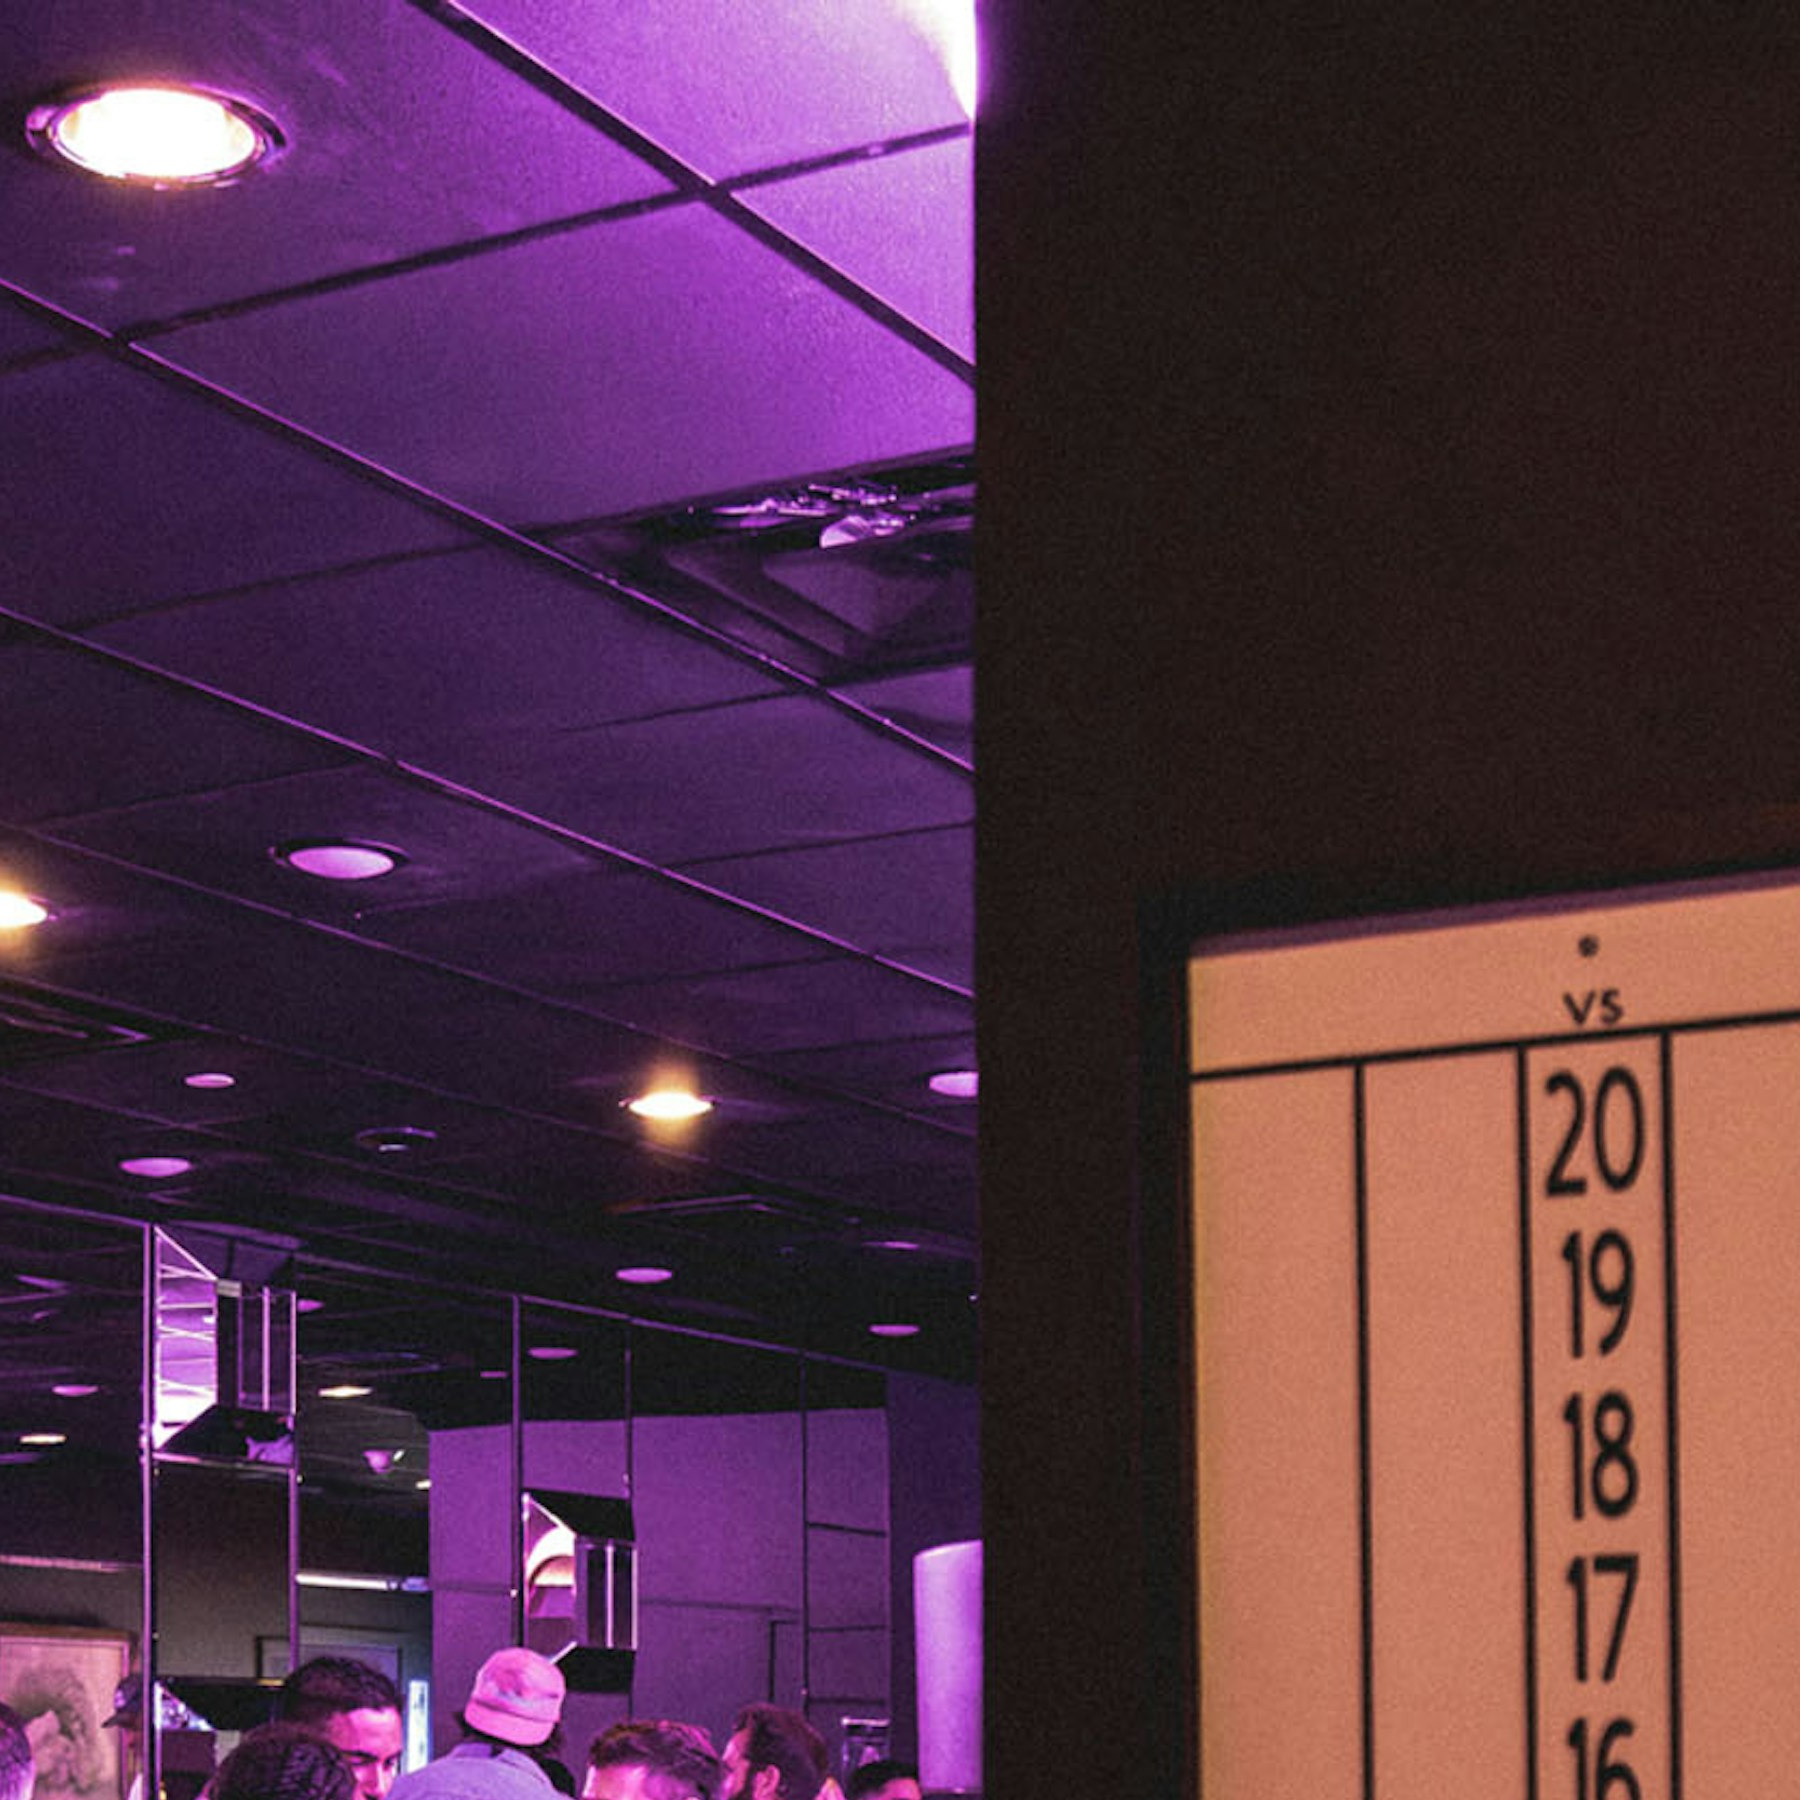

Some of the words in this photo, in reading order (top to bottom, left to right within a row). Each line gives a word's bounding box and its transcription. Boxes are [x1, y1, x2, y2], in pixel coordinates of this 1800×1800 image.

[1544, 1065, 1646, 1198] 20
[1561, 1228, 1635, 1358] 19
[1562, 1391, 1639, 1521] 18
[1566, 1554, 1640, 1683] 17
